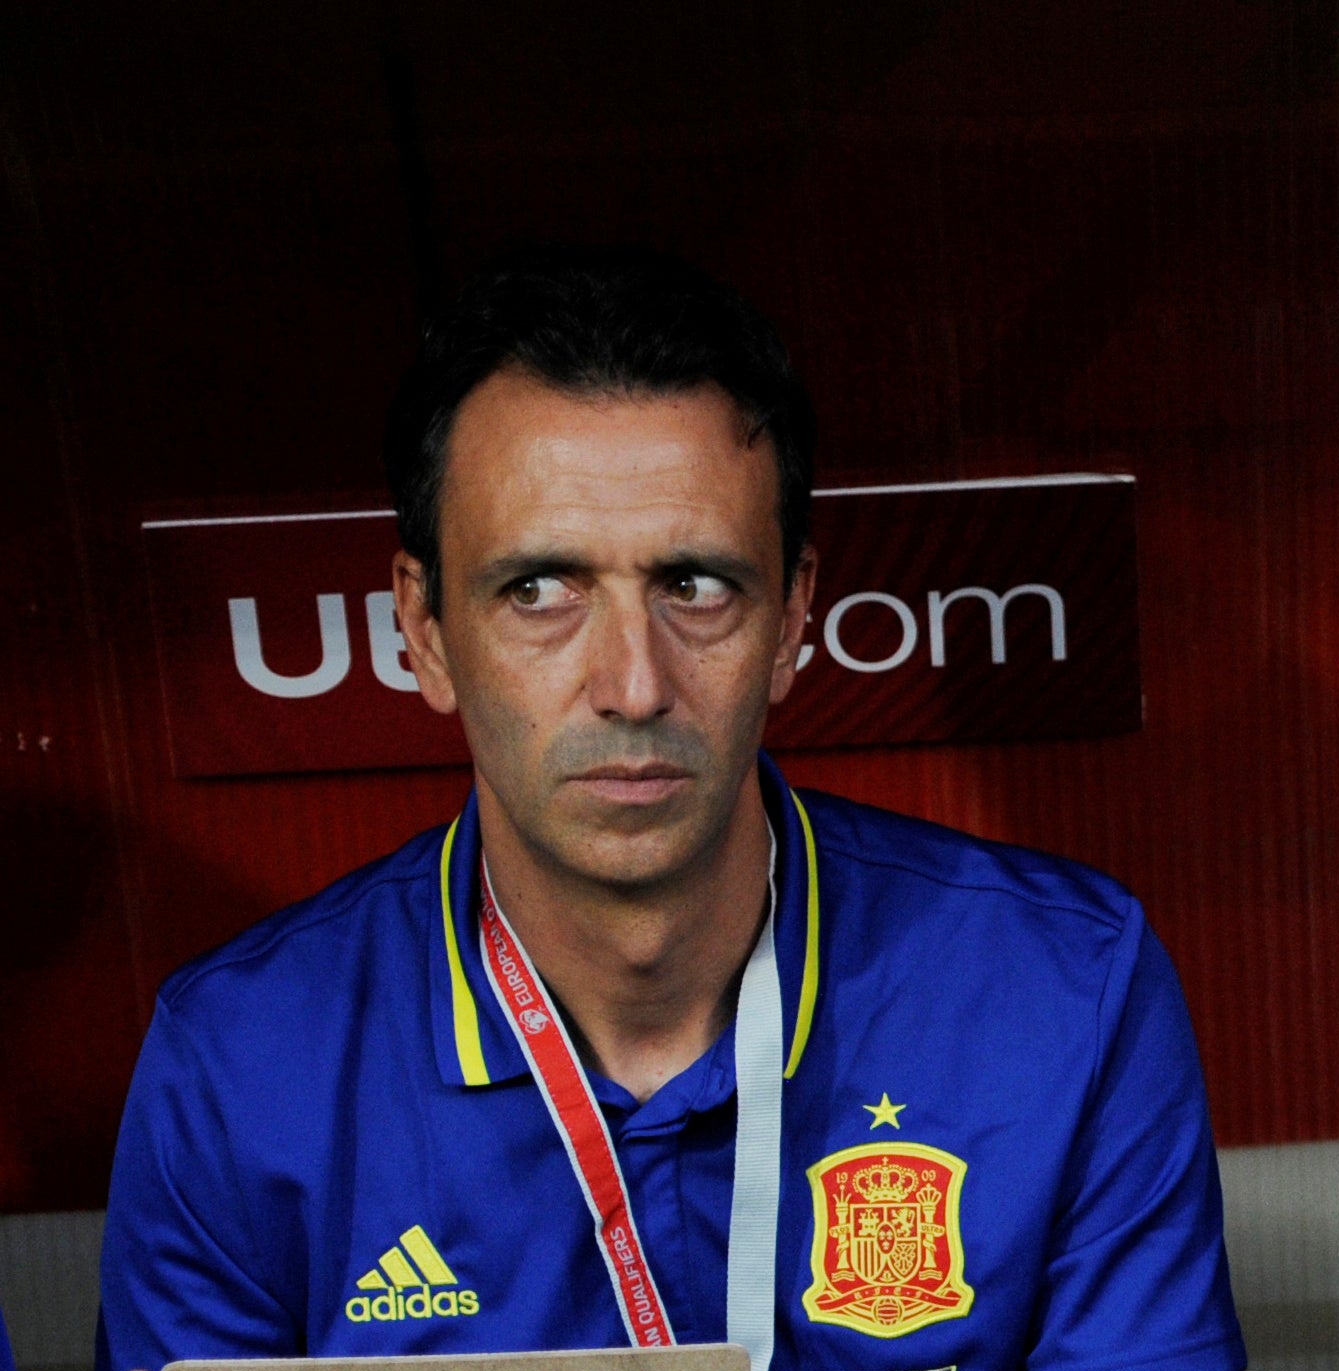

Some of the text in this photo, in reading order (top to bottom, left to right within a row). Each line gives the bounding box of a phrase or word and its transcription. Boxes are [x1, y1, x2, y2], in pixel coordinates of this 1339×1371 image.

[490, 924, 534, 1006] EUROPEAN
[345, 1284, 480, 1322] adidas
[610, 1226, 655, 1325] QUALIFIERS
